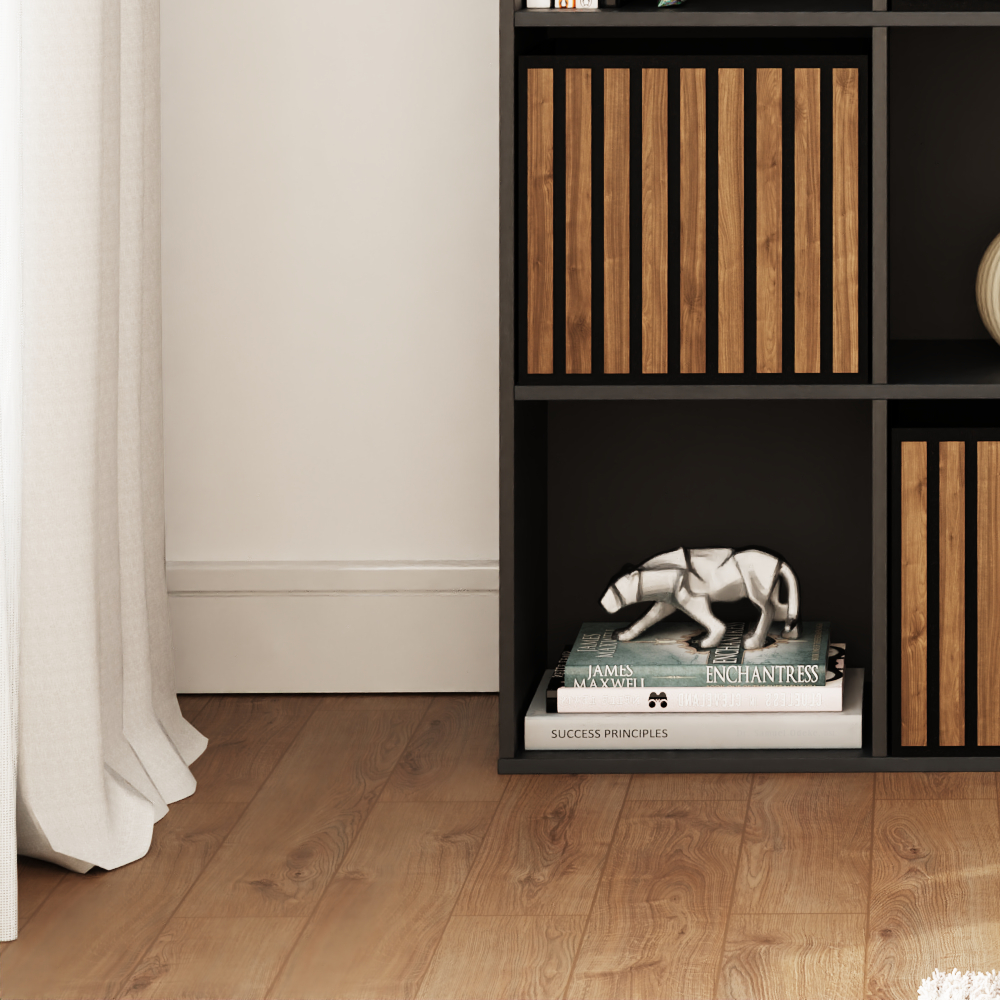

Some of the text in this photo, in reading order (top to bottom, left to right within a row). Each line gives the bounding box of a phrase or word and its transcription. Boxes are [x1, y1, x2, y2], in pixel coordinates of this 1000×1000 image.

[587, 664, 634, 679] JAMES
[705, 664, 819, 684] ENCHANTRESS
[551, 729, 669, 739] SUCCESS PRINCIPLES
